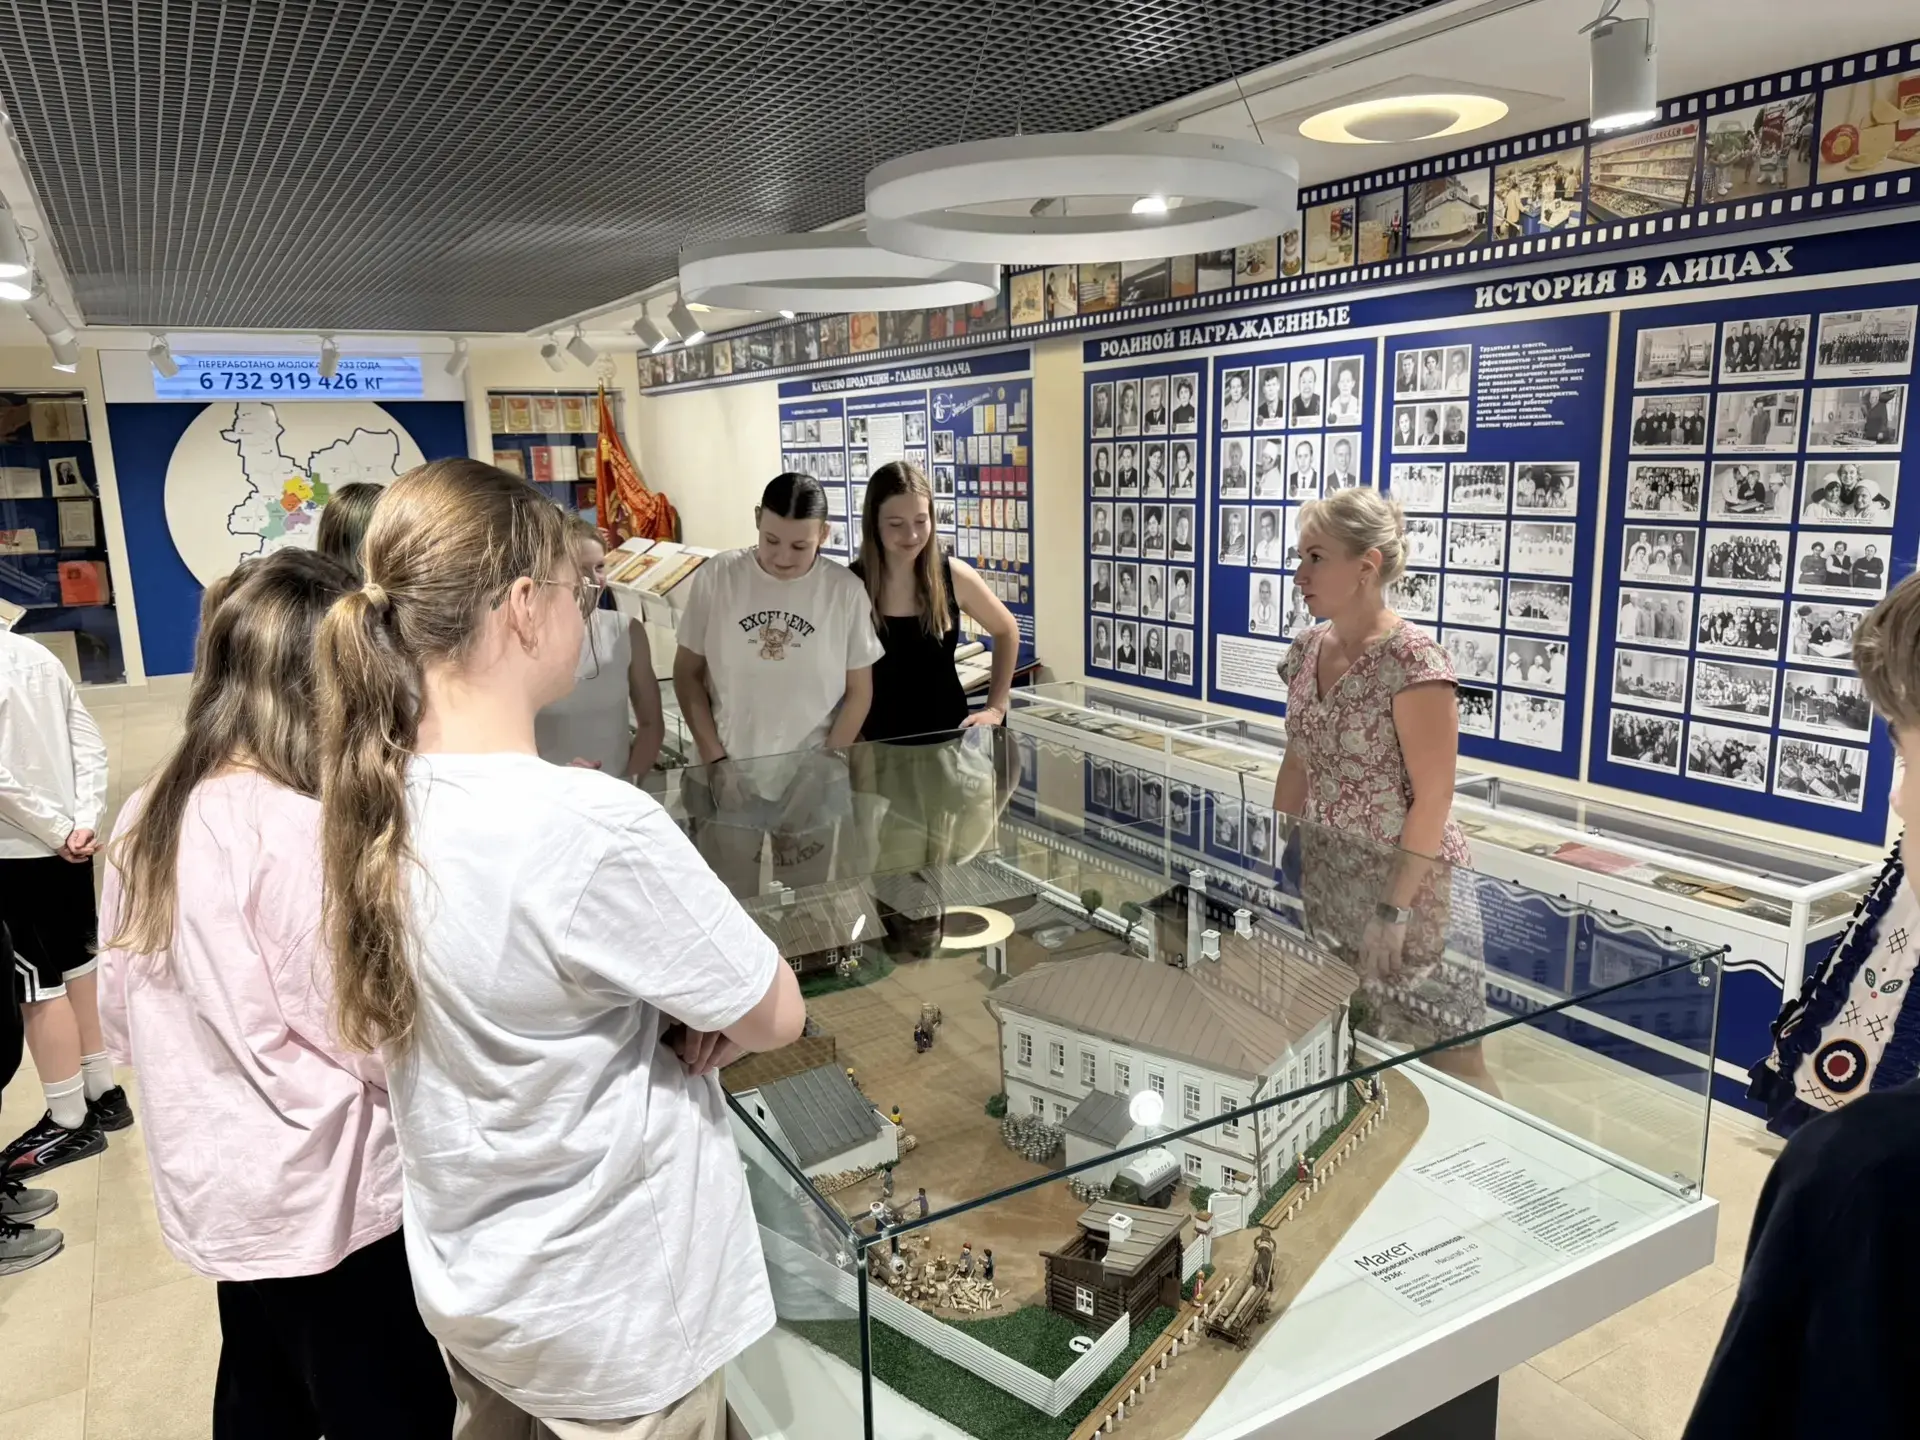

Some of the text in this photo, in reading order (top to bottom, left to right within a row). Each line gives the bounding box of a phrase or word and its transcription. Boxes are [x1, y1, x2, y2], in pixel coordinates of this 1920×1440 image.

[1475, 246, 1793, 308] ИСТОРИЯ В ЛИЦАХ
[1100, 306, 1350, 357] РОДИНОЙ НАГРАЖДЕННЫЕ
[198, 360, 274, 369] ПЕРЕРАБОТАНО
[355, 362, 381, 370] ГОДА
[934, 362, 971, 378] ЗАДАЧА
[200, 373, 213, 389] 6
[220, 373, 263, 389] 732
[270, 373, 310, 389] 919
[319, 372, 358, 389] 426
[1149, 1161, 1171, 1179] МОЛОКО
[1354, 1242, 1413, 1271] Макет
